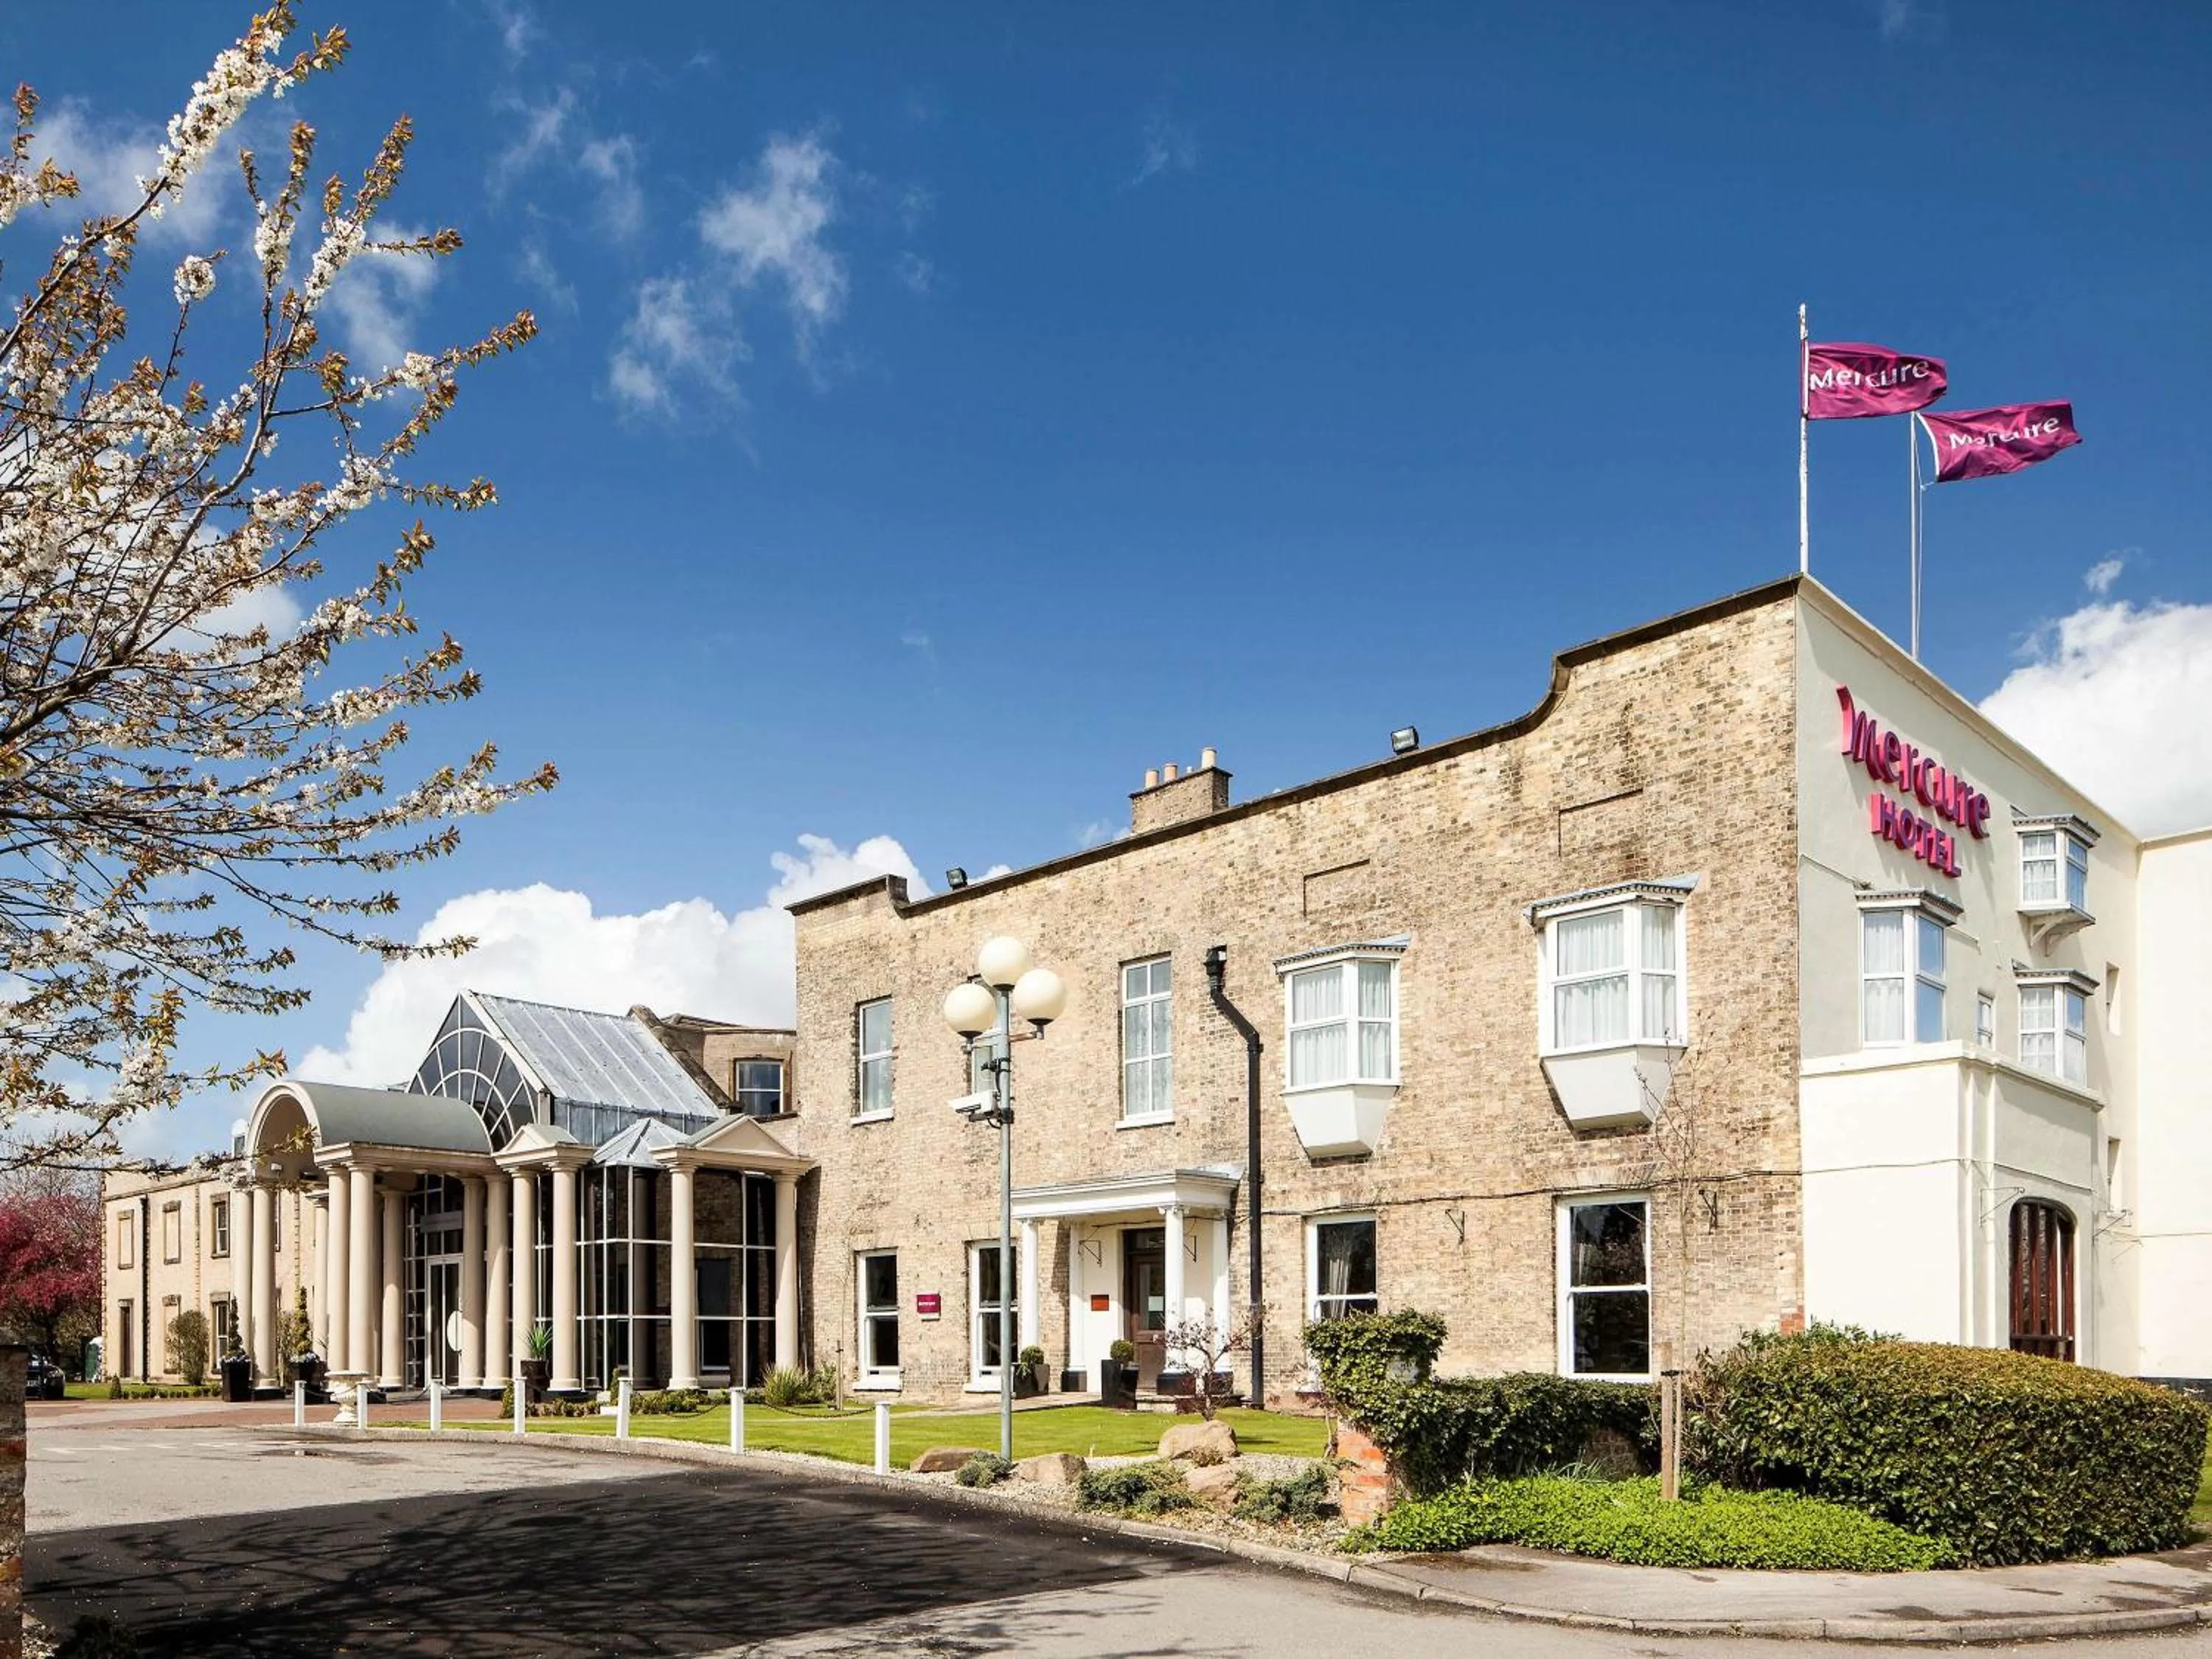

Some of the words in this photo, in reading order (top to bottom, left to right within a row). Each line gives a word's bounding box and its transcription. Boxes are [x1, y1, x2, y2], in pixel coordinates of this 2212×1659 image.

[1809, 361, 1930, 390] Mercure
[1836, 684, 1990, 839] Mercure
[1869, 792, 1962, 877] HOTEL
